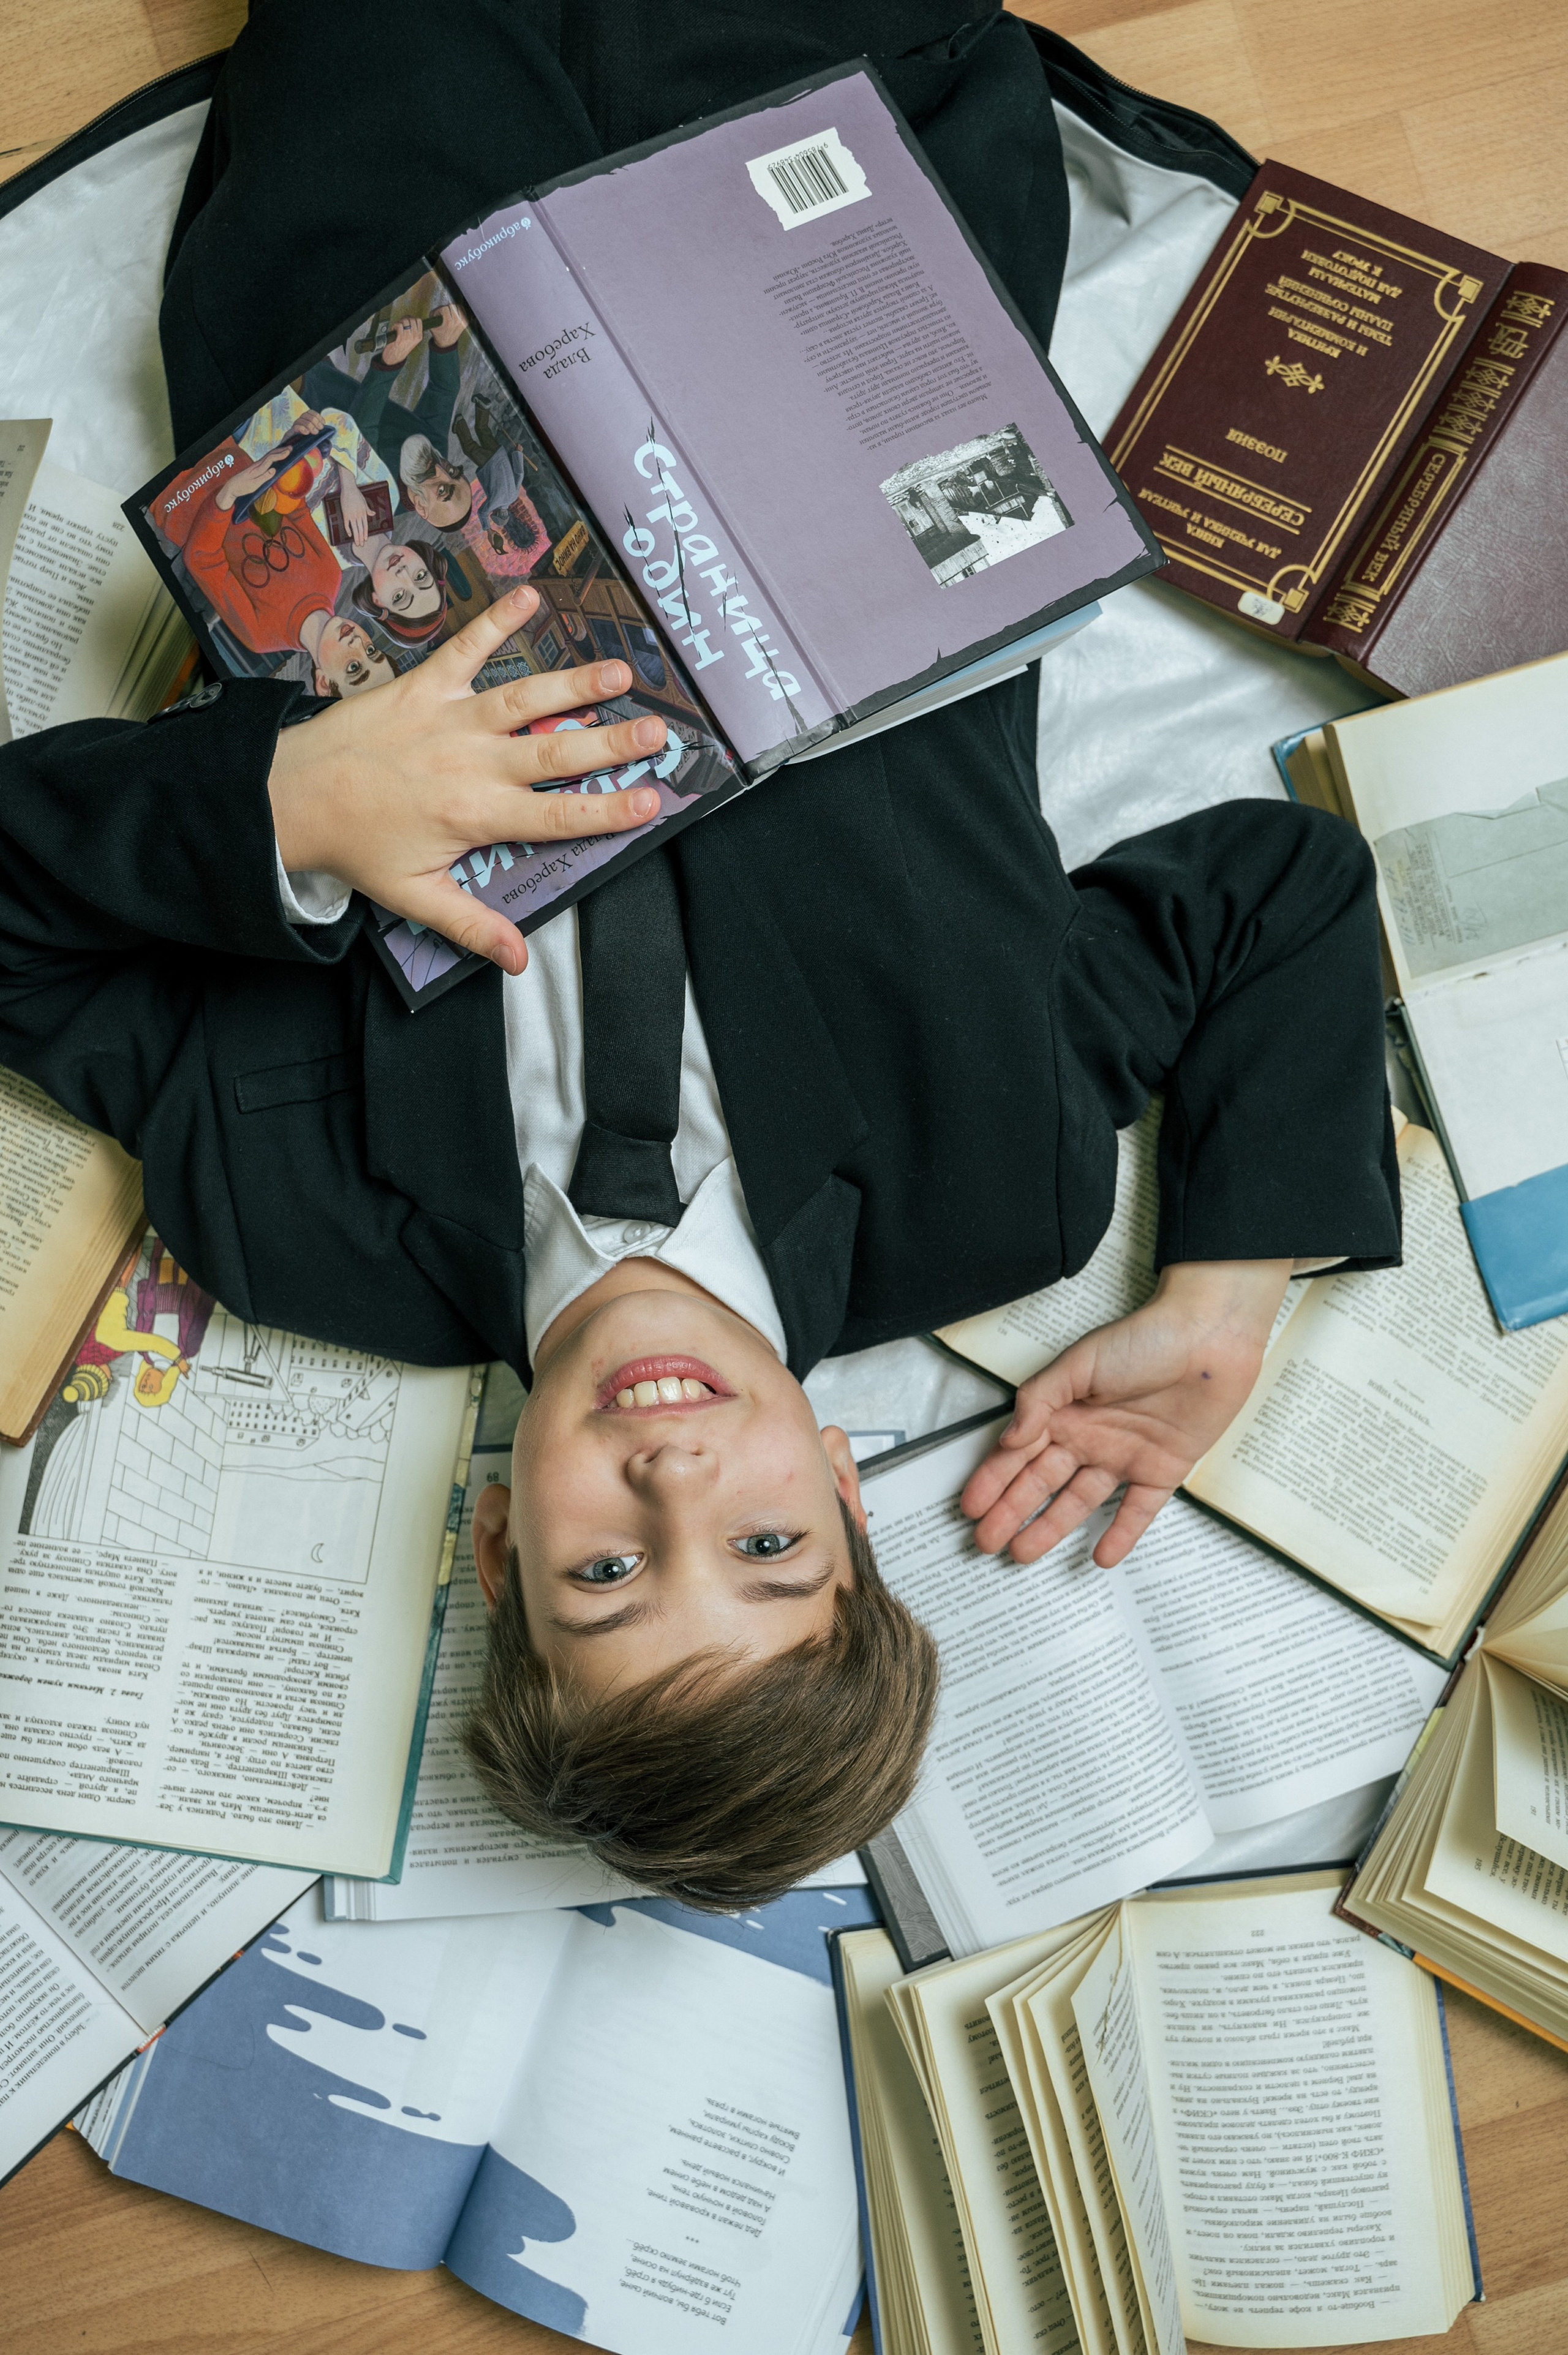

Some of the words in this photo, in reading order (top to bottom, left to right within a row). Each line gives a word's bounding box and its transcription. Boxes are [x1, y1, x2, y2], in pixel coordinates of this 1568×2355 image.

[794, 144, 821, 160] 785604
[766, 155, 793, 171] 348925
[453, 221, 521, 271] абрикобукс
[1300, 249, 1378, 289] ПОДГОТОВКИ
[1331, 249, 1371, 272] УРОКУ
[1370, 265, 1383, 277] К
[1277, 274, 1349, 312] СОЧИНЕНИЙ
[1307, 266, 1382, 304] МАТЕРИАЛЫ
[1376, 281, 1403, 298] ДЛЯ
[1264, 283, 1347, 325] РАЗВЕРНУТЫЕ
[1345, 318, 1359, 330] И
[1348, 305, 1394, 332] ПЛАНЫ
[1267, 306, 1357, 351] КОММЕНТАРИИ
[1356, 323, 1392, 347] ТЕМЫ
[518, 321, 596, 372] Харебова
[1287, 327, 1341, 358] КРИТИКА
[1354, 344, 1369, 357] И
[542, 346, 592, 379] Влада
[1224, 427, 1287, 463] ПОЭЗИЯ
[1158, 452, 1195, 477] ВЕК
[163, 459, 225, 513] абрикобукс
[1137, 488, 1191, 518] УЧИТЕЛЯ
[1192, 467, 1305, 526] СЕРЕБРЯНЫЙ
[1379, 453, 1446, 551] СЕРЕБРЯНЫЙ
[1189, 510, 1202, 523] И
[573, 525, 586, 543] ВИНО
[1186, 521, 1225, 548] КНИГА
[1203, 516, 1256, 548] УЧЕНИКА
[568, 537, 577, 550] НА
[1254, 540, 1282, 559] ДЛЯ
[555, 545, 571, 570] ВИНОС
[1360, 550, 1390, 582] ВЕК
[635, 445, 802, 703] Страница
[623, 527, 725, 670] один
[501, 852, 573, 904] Харебова
[486, 1470, 500, 1483] 89
[264, 1633, 304, 1646] шмыгнул
[307, 1640, 344, 1654] Спиноза
[1474, 1857, 1483, 1871] 195
[170, 1914, 201, 1943] цепочка
[1250, 1929, 1265, 1937] 222
[144, 1946, 165, 1967] тихим
[120, 1965, 146, 1991] шелестом
[63, 2022, 86, 2042] Забегу
[14, 2044, 61, 2089] понедельник
[706, 2097, 729, 2111] грязь.
[703, 2109, 742, 2130] умирали,
[736, 2109, 767, 2125] ногами
[668, 2124, 703, 2143] раннем,
[688, 2117, 727, 2138] золотясь,
[741, 2125, 768, 2140] карпы
[767, 2120, 801, 2140] Вмятые
[703, 2138, 741, 2157] рассвете
[728, 2133, 759, 2150] слитки,
[769, 2134, 796, 2152] Всюду
[748, 2154, 778, 2172] вокруг,
[758, 2145, 791, 2164] Словно
[680, 2158, 703, 2171] день.
[777, 2167, 786, 2176] И
[662, 2167, 690, 2181] синем
[690, 2176, 712, 2189] небе
[701, 2167, 731, 2182] новый
[646, 2187, 668, 2202] тине,
[670, 2182, 690, 2196] тень.
[718, 2187, 747, 2202] дедом
[730, 2178, 776, 2201] Начинался
[668, 2197, 710, 2217] кровавой
[691, 2191, 725, 2208] ночную
[746, 2196, 763, 2208] над
[731, 2206, 766, 2226] Головой
[764, 2204, 771, 2213] А
[717, 2215, 744, 2229] лежал
[744, 2224, 763, 2238] Дед
[1287, 2239, 1335, 2250] ухватился
[1337, 2234, 1386, 2246] торопливо
[630, 2253, 658, 2269] осине,
[658, 2250, 688, 2266] землю
[624, 2266, 650, 2281] сгрёб,
[658, 2264, 669, 2274] на
[687, 2261, 720, 2278] ногами
[618, 2278, 642, 2293] сыне,
[669, 2269, 709, 2288] вздёрнул
[718, 2273, 741, 2288] Чтоб
[641, 2288, 674, 2304] волчий
[657, 2278, 704, 2300] где-нибудь
[709, 2283, 722, 2293] же
[722, 2288, 736, 2300] Тут
[675, 2298, 690, 2312] бы,
[703, 2296, 711, 2305] б
[710, 2299, 732, 2313] Если
[690, 2305, 710, 2318] тебя
[710, 2313, 727, 2326] Вот
